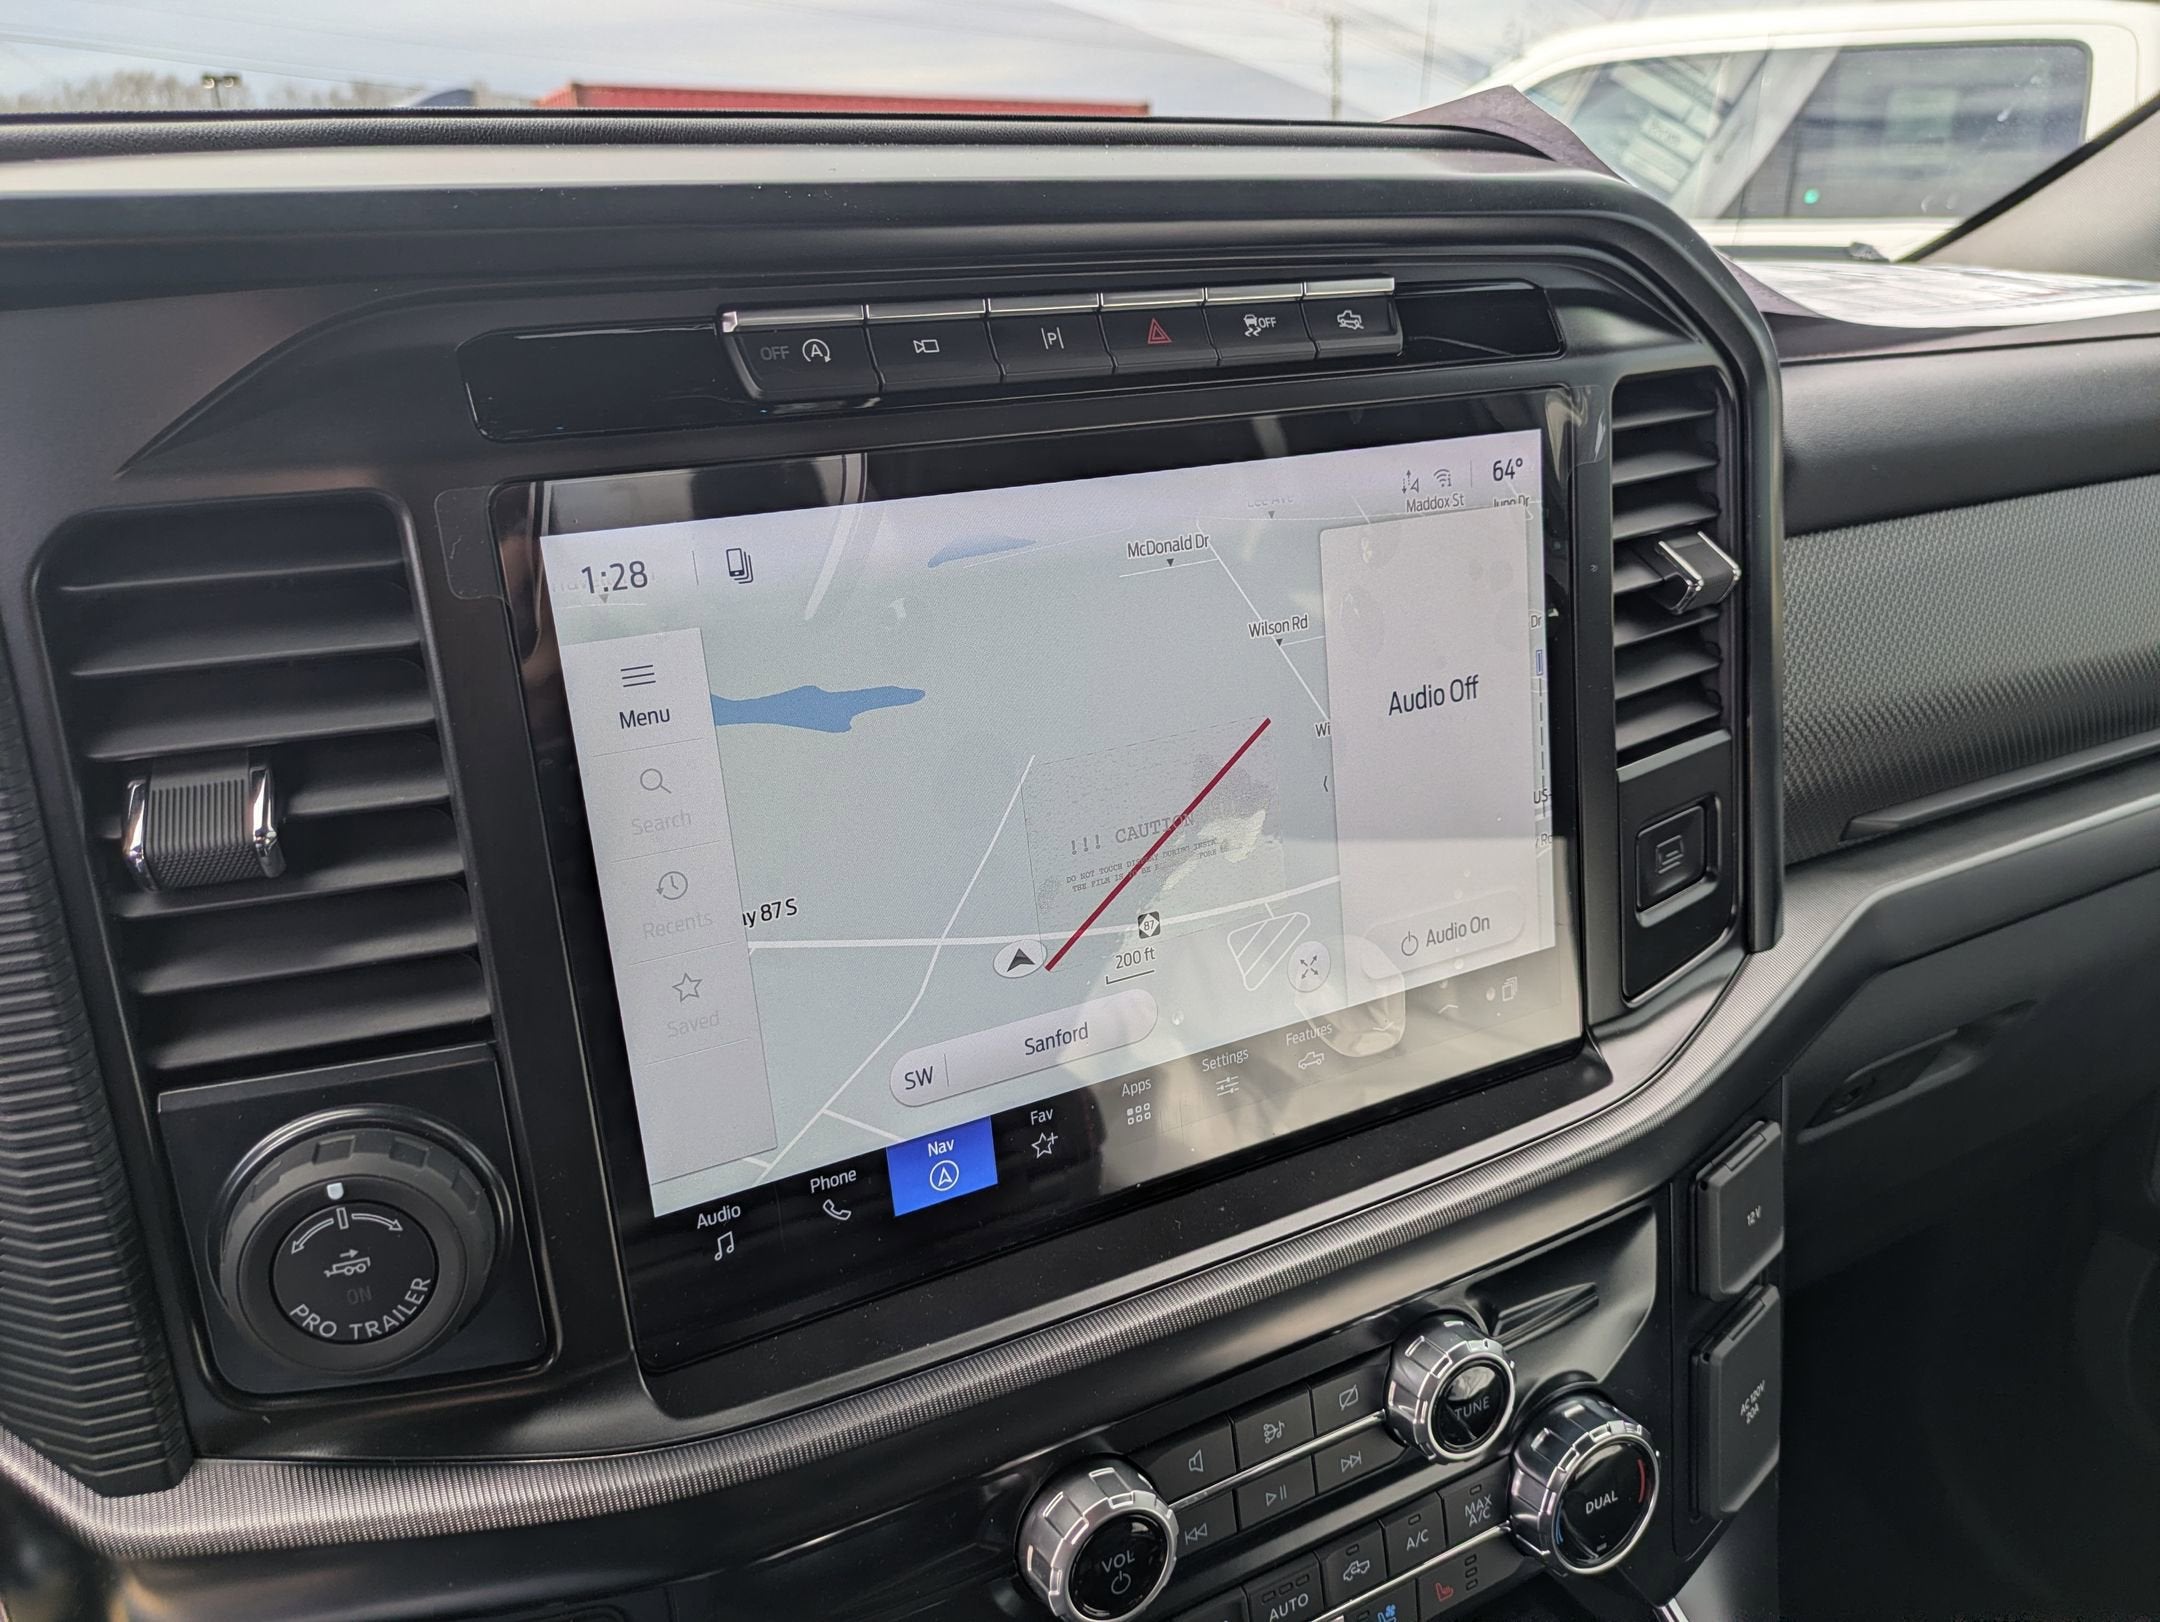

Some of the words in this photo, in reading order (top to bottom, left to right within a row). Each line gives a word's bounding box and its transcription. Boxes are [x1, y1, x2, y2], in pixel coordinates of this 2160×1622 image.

[1258, 316, 1277, 329] OFF
[760, 345, 790, 361] OFF
[1406, 497, 1450, 513] Maddox
[1452, 493, 1465, 507] St
[1127, 535, 1194, 559] McDonald
[1194, 534, 1209, 550] Dr
[581, 560, 648, 594] 1:28
[1248, 618, 1289, 639] Wilson
[1291, 614, 1308, 632] Rd
[1389, 681, 1445, 716] Audio
[1449, 674, 1479, 705] Off
[619, 706, 671, 730] Menu
[631, 809, 692, 836] Search
[1115, 813, 1195, 844] CAUTION
[1066, 875, 1076, 884] DO
[1081, 870, 1095, 880] NOT
[760, 900, 782, 922] 87
[785, 897, 798, 916] S
[642, 912, 713, 941] Recents
[1143, 918, 1156, 932] 87
[1426, 922, 1467, 947] Audio
[1470, 915, 1491, 935] On
[1114, 949, 1142, 971] 200
[1142, 946, 1156, 963] ft
[666, 1011, 720, 1038] Saved
[1285, 1021, 1333, 1047] Features
[904, 1066, 933, 1090] SW
[1024, 1022, 1089, 1055] Sanford
[1201, 1047, 1249, 1073] Settings
[1121, 1077, 1152, 1098] Apps
[1030, 1108, 1054, 1126] Fav
[928, 1138, 954, 1158] Nav
[810, 1168, 857, 1194] Phone
[696, 1203, 741, 1229] Audio
[346, 1285, 373, 1304] ON
[289, 1303, 337, 1339] PRO
[349, 1276, 432, 1341] TRAILER
[1454, 1396, 1490, 1419] TUNE
[1464, 1493, 1493, 1519] MAX
[1585, 1489, 1619, 1515] DUAL
[1468, 1505, 1492, 1528] A/C
[1406, 1529, 1429, 1551] A/C
[1101, 1550, 1135, 1574] VOL
[1268, 1592, 1309, 1622] AUTO
